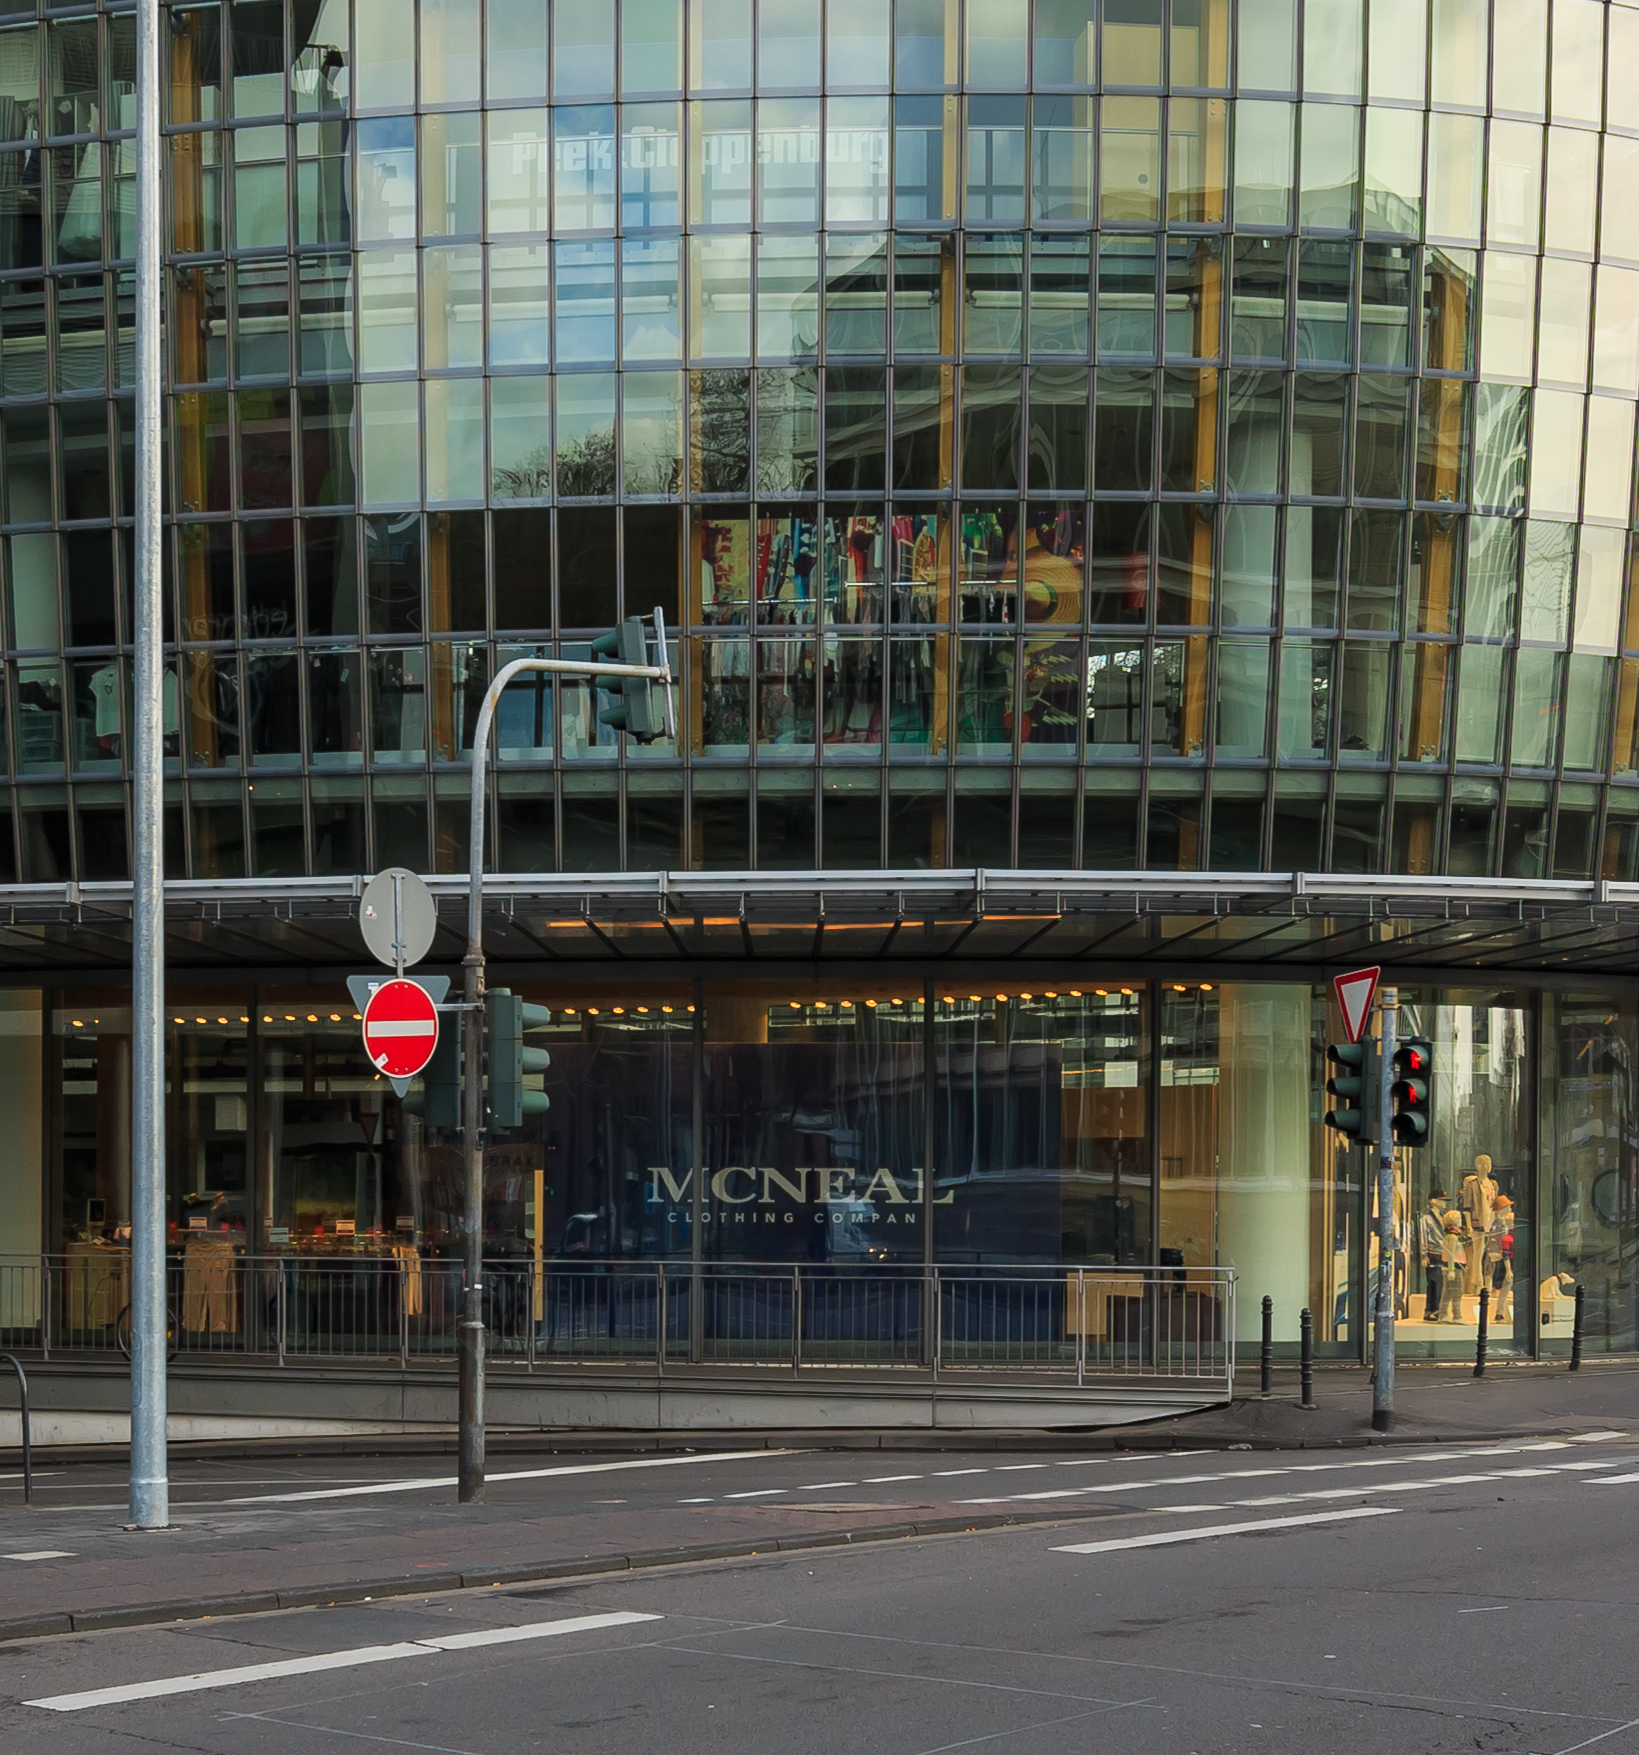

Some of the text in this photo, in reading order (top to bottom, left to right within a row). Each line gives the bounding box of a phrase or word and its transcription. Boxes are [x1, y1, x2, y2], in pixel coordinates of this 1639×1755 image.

[512, 131, 612, 174] Peek
[646, 1167, 955, 1205] MCNEAL
[667, 1211, 926, 1224] CLOTHING COMPAN
